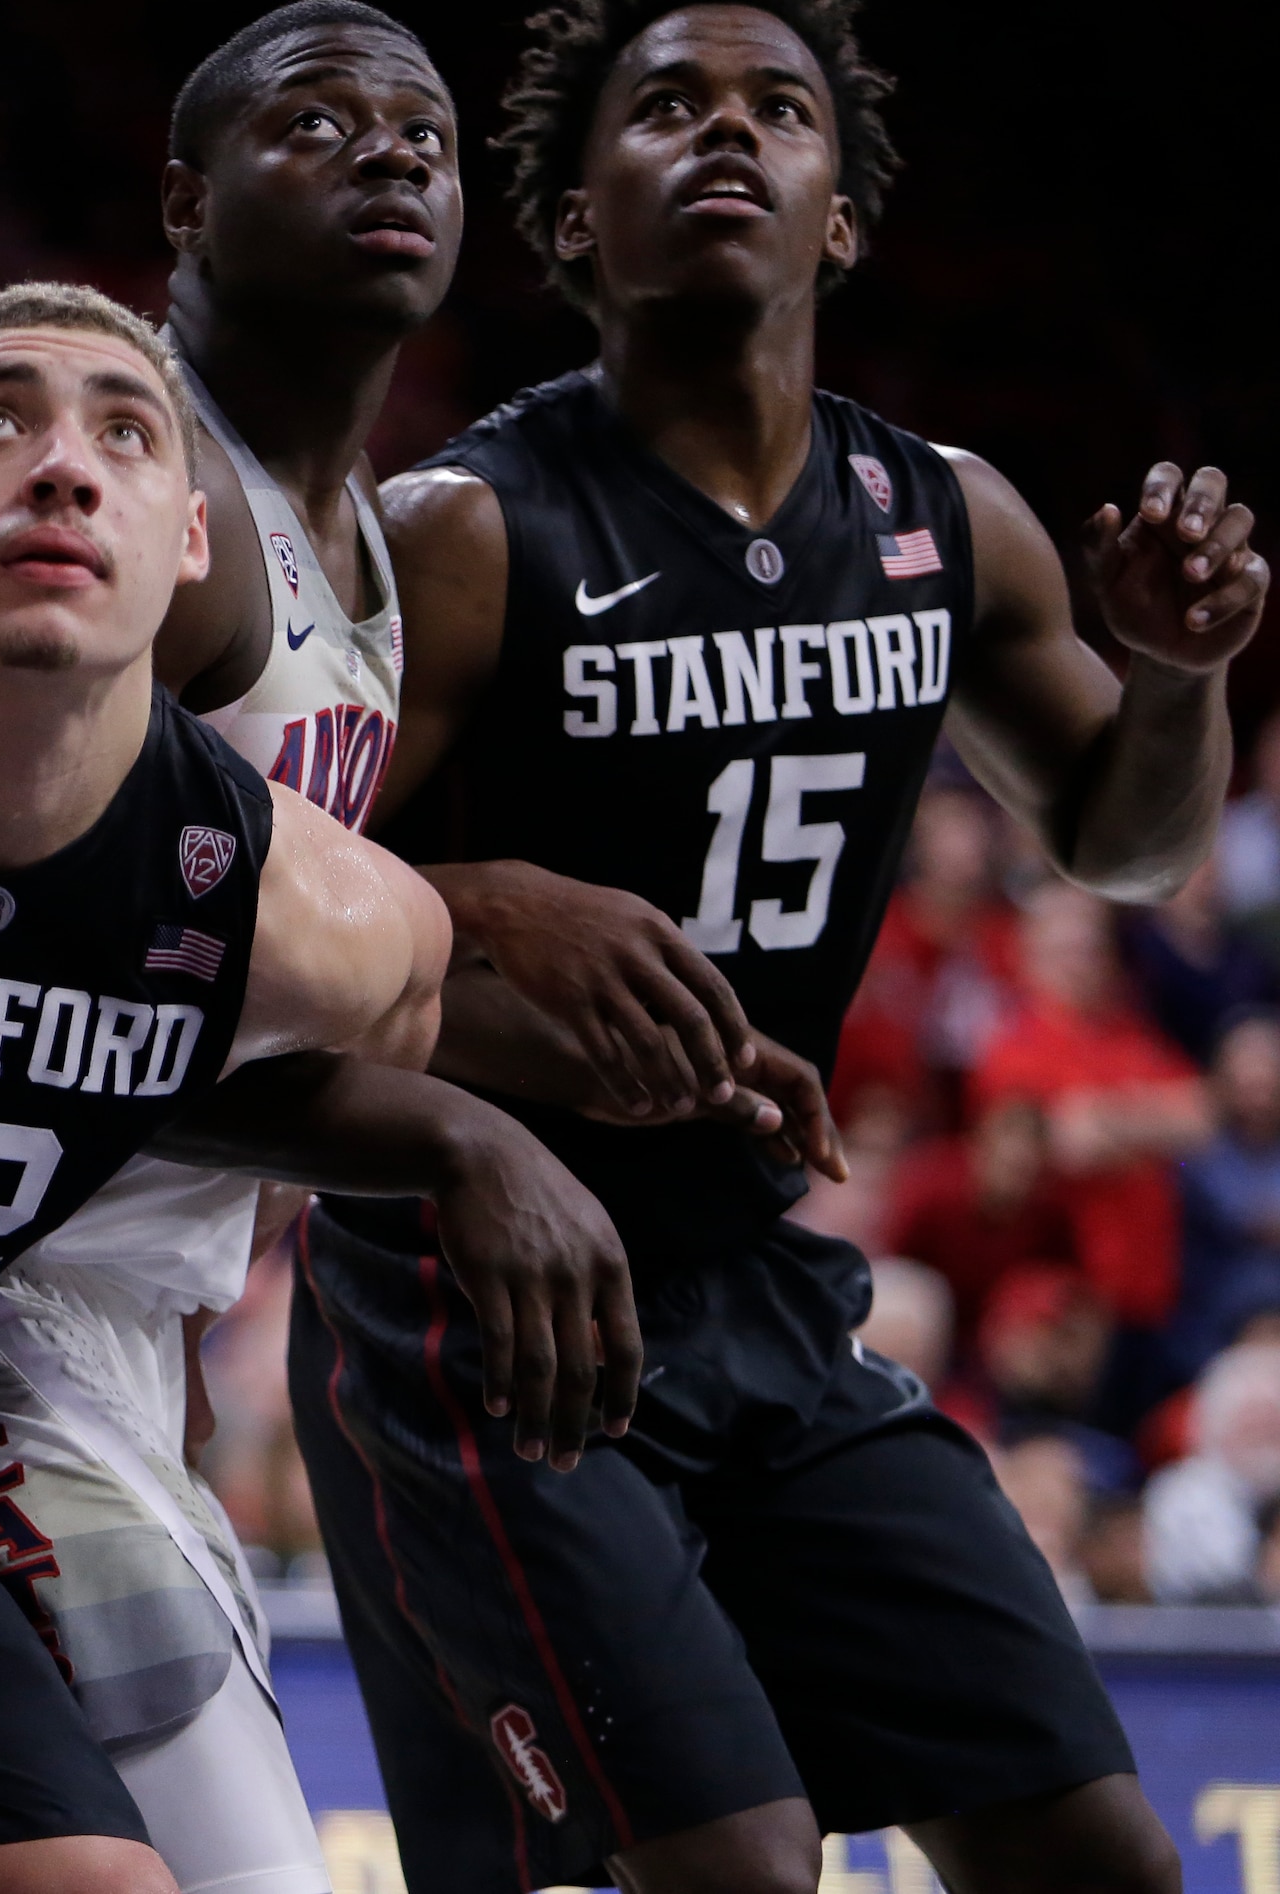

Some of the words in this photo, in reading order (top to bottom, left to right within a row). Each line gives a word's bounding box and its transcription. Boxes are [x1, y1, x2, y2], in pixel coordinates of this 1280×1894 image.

[563, 608, 951, 737] STANFORD
[268, 703, 396, 835] ARIZO
[184, 829, 232, 873] PAC
[188, 857, 215, 883] 12
[681, 752, 865, 953] 15
